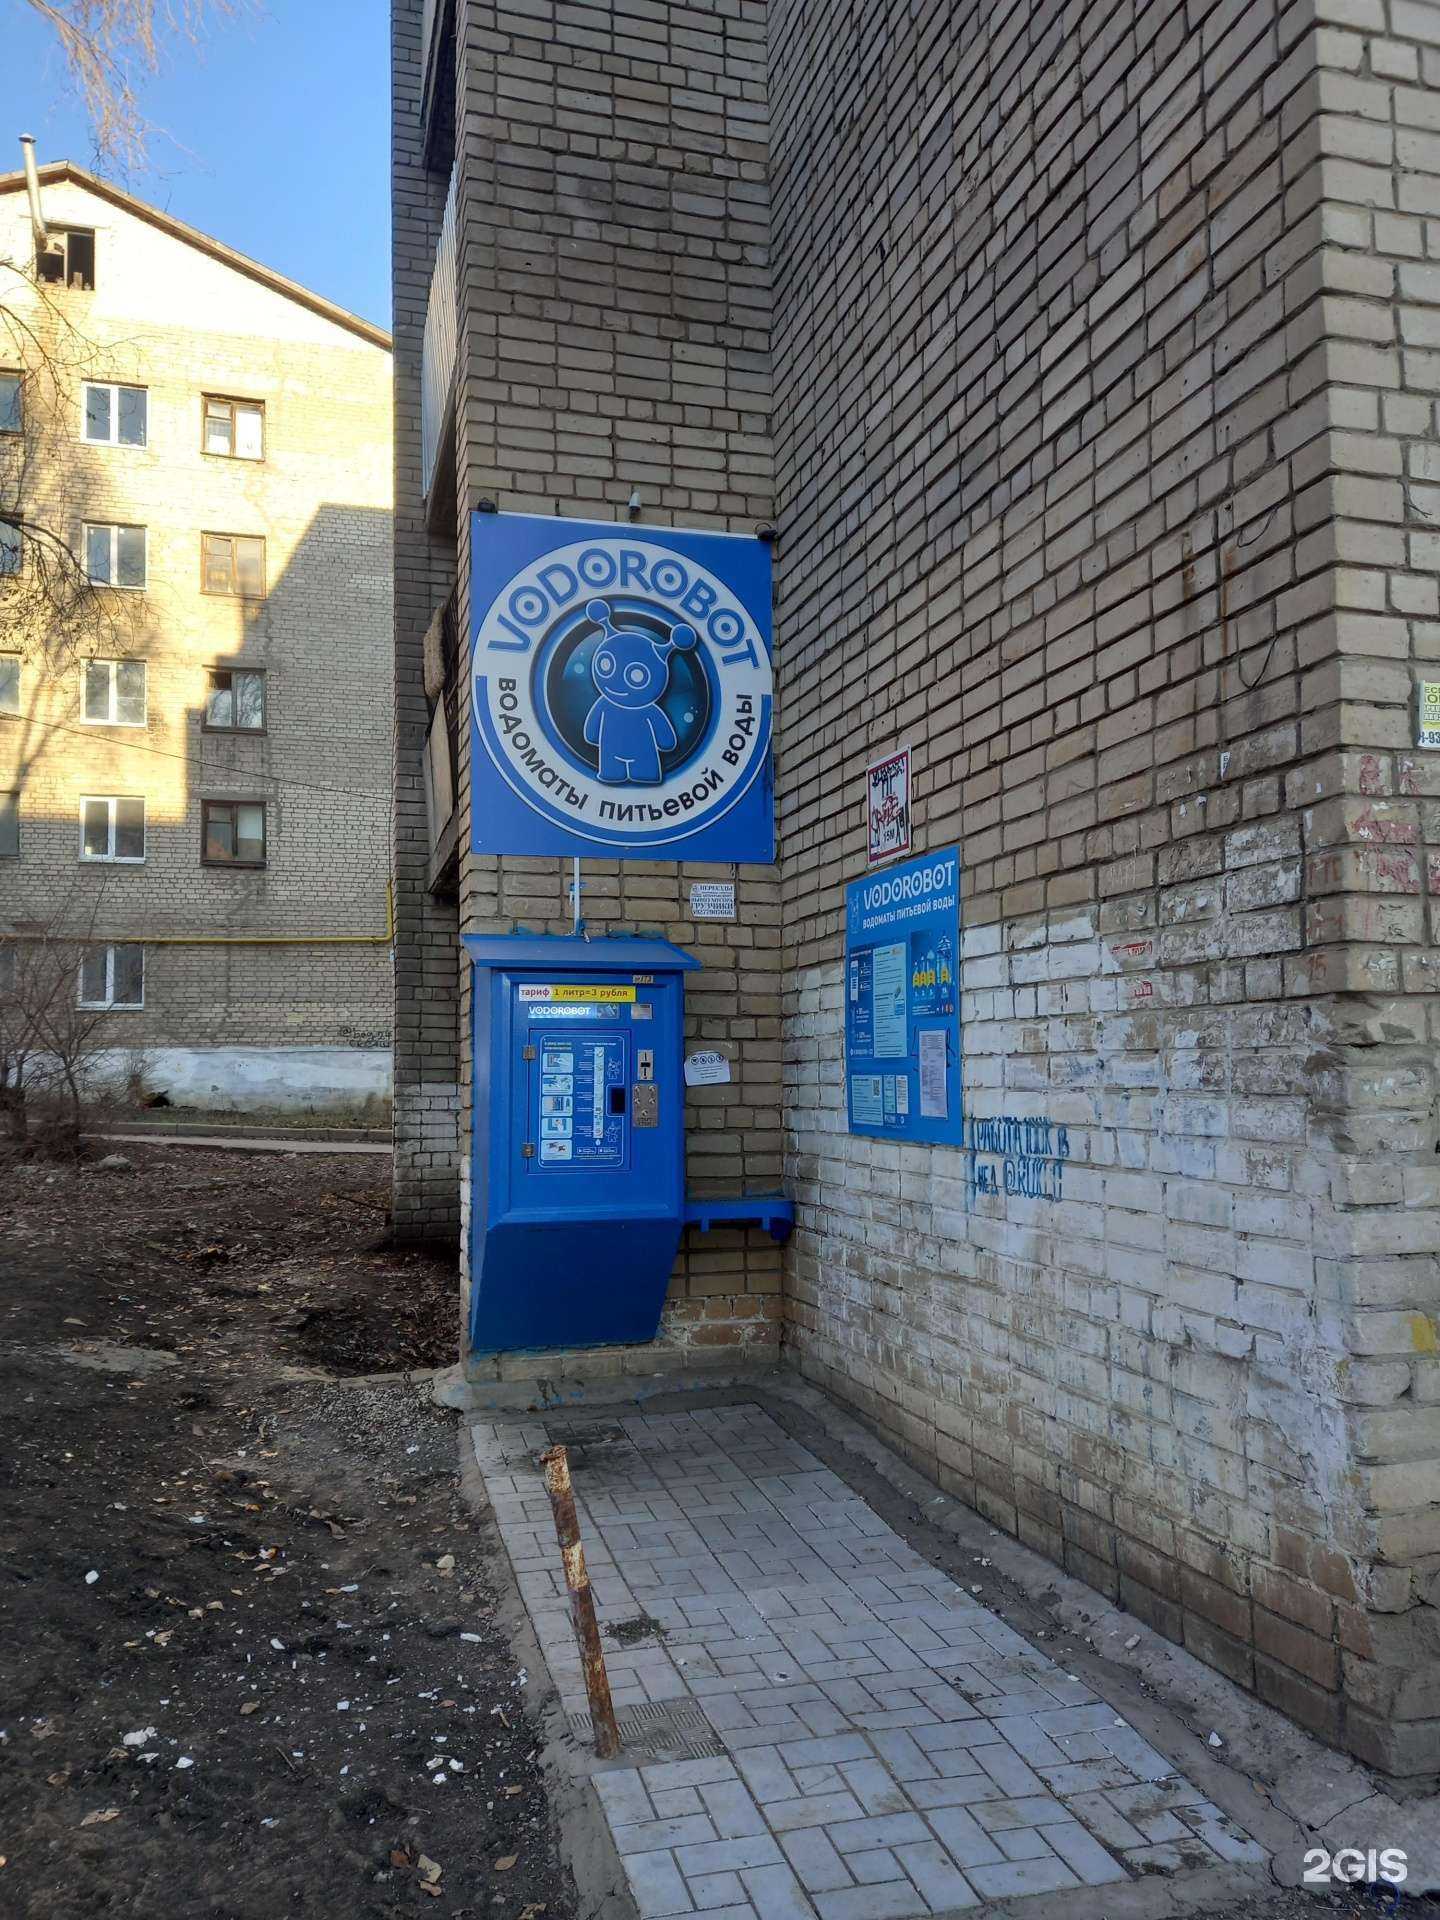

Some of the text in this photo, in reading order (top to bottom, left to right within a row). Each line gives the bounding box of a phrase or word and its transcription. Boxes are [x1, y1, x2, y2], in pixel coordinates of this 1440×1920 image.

[488, 548, 760, 670] VODOROBOT
[863, 861, 955, 910] VODOROBOT
[863, 895, 956, 929] ВОДОМАТЫ ПИТЬЕВОЙ ВОДЫ
[521, 988, 550, 998] тариф
[599, 989, 628, 998] рубля
[528, 1006, 592, 1016] VODOROBOT
